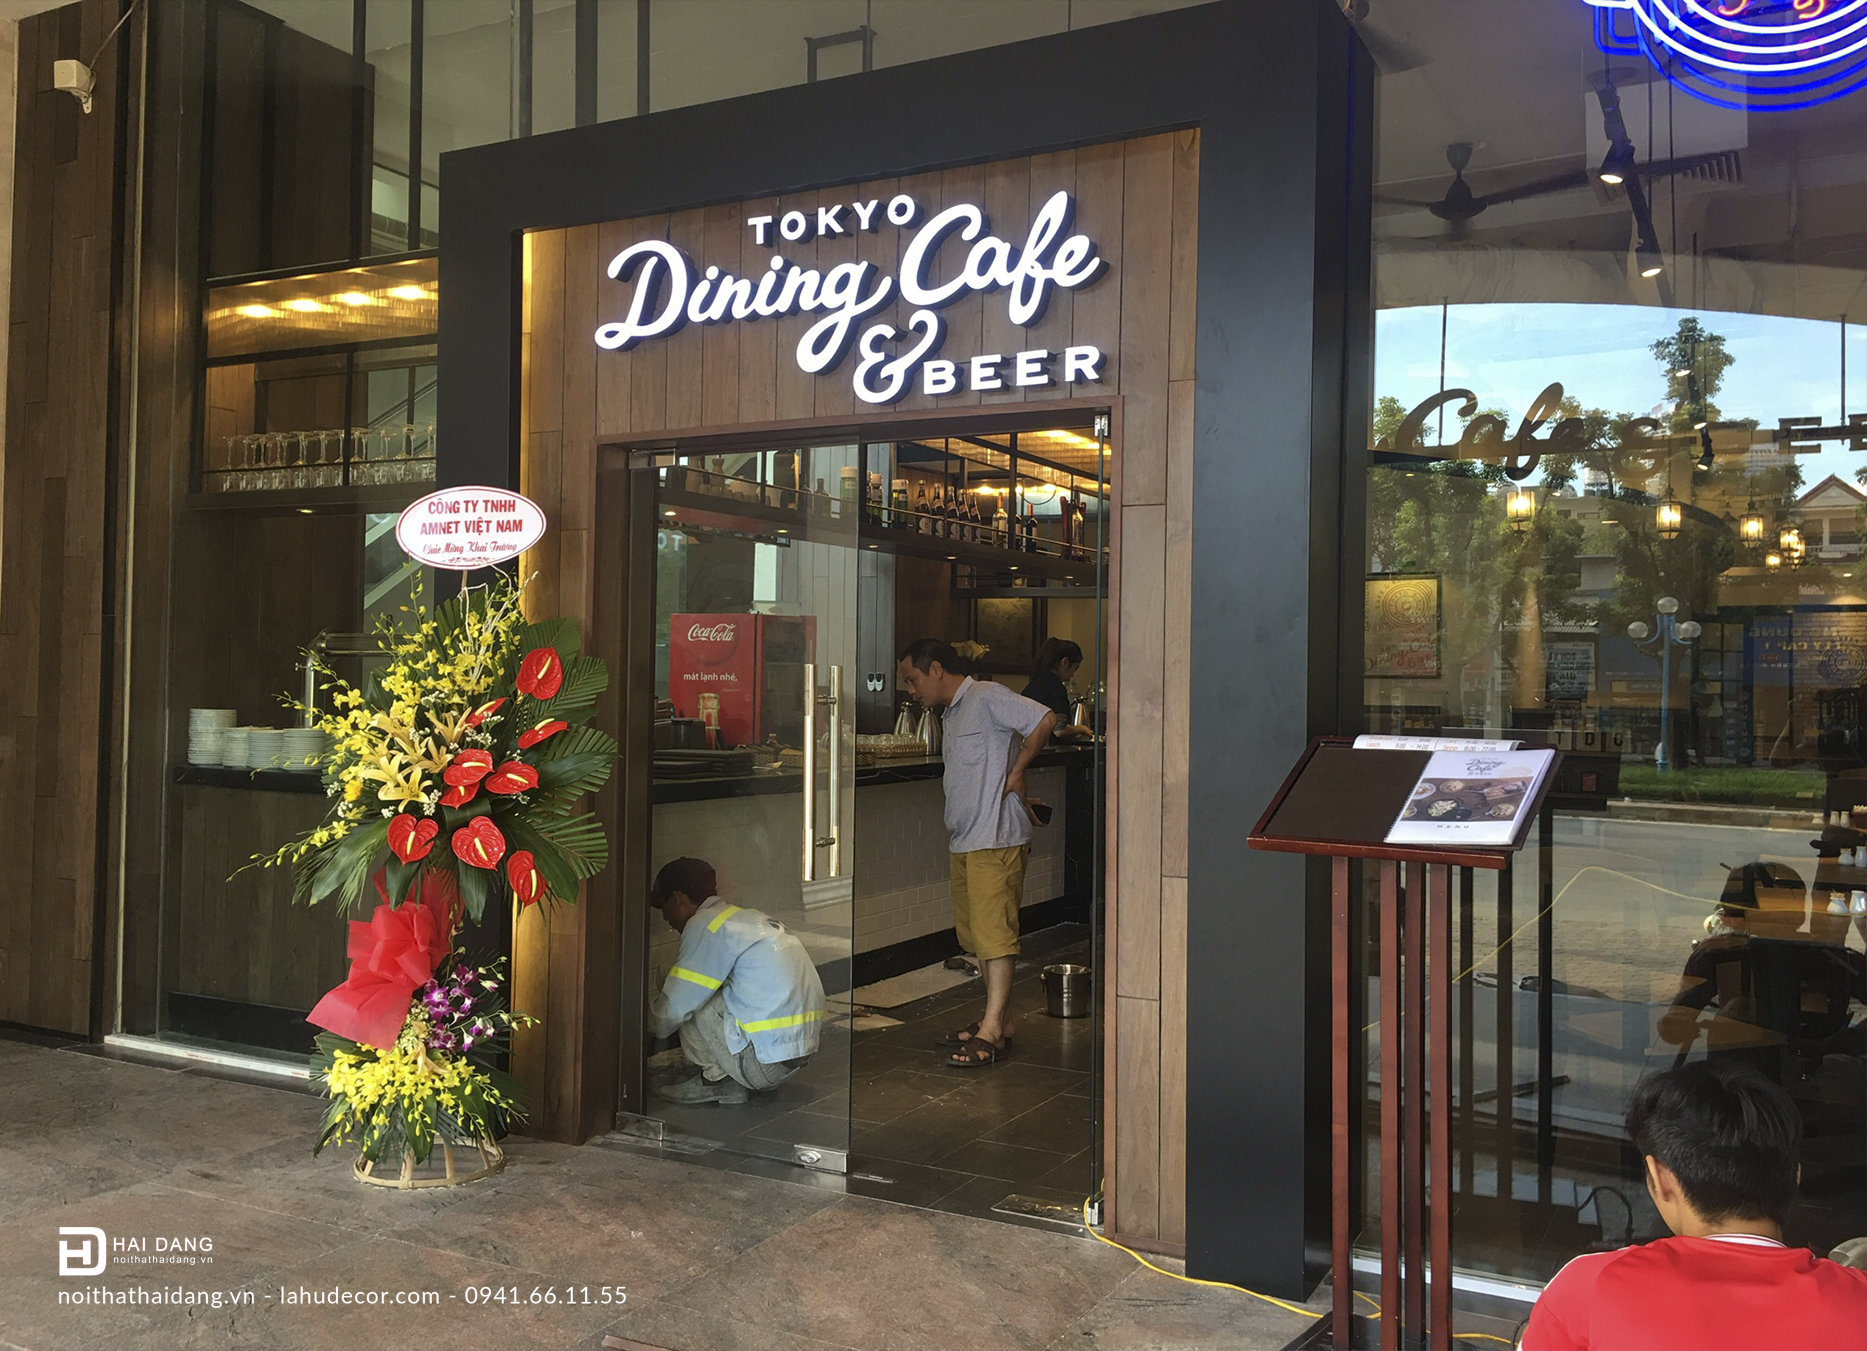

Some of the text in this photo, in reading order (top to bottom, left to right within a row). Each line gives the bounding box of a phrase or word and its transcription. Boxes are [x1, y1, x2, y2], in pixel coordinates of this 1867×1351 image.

[748, 194, 916, 246] TOKYO
[595, 190, 1101, 374] Dining Cafe
[853, 309, 1101, 403] & BEER
[1396, 381, 1592, 481] Cafe
[428, 497, 516, 514] CÔNG TY TNHH
[420, 516, 523, 536] AMNET VIỆT NAM
[467, 540, 488, 553] Khai
[687, 622, 738, 642] Coca-Cola
[683, 672, 699, 681] mát
[700, 672, 719, 683] lạnh
[1584, 732, 1595, 746] D
